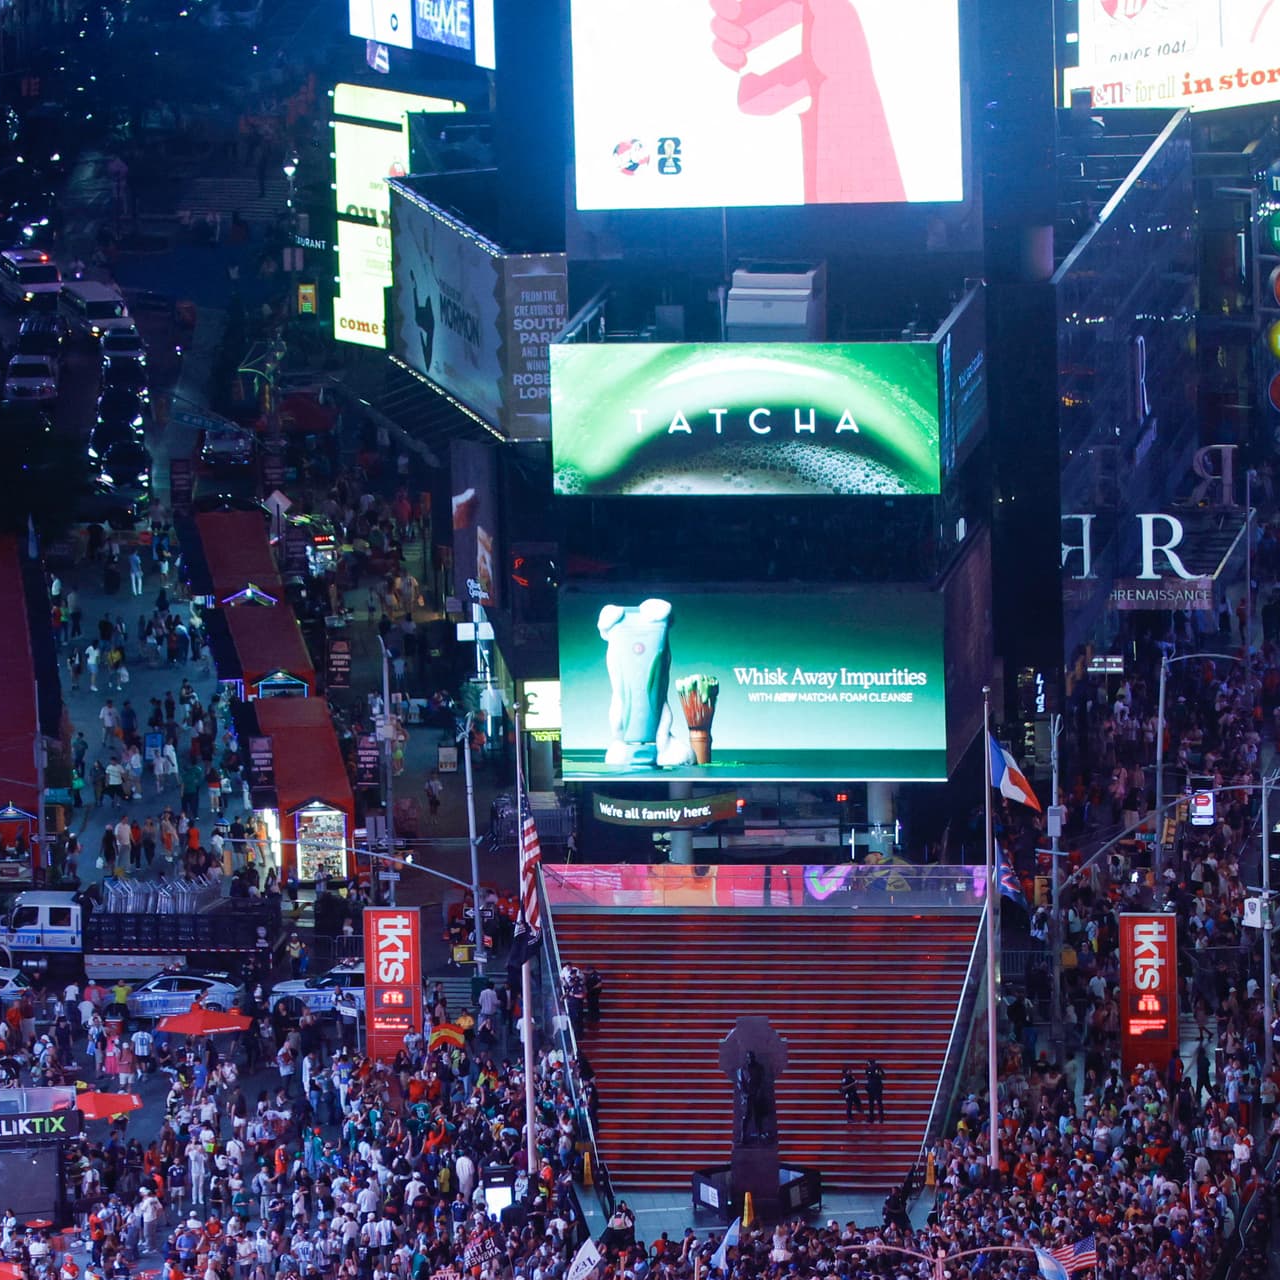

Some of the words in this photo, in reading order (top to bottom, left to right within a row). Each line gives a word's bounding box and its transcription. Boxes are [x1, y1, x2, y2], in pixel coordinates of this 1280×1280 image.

[1135, 82, 1156, 103] for
[1158, 75, 1176, 99] all
[1181, 71, 1213, 96] in
[521, 291, 542, 302] FROM
[544, 291, 558, 302] THE
[514, 305, 553, 317] CREATORS
[554, 305, 565, 316] OF
[340, 316, 379, 335] come
[513, 318, 566, 331] SOUTH
[513, 374, 551, 386] ROBE
[520, 387, 551, 399] LOP
[629, 408, 860, 434] TATCHA
[1135, 513, 1208, 580] R
[1118, 590, 1211, 601] RENAISSANCE
[733, 668, 788, 686] Whisk
[791, 668, 837, 689] Away
[840, 668, 927, 689] Impurities
[748, 693, 772, 703] WITH
[798, 693, 837, 703] MATCHA
[839, 693, 868, 703] FOAM
[868, 693, 913, 703] CLEANSE
[1035, 673, 1045, 713] Lids
[599, 802, 623, 817] We're
[625, 804, 639, 818] all
[641, 804, 681, 822] family
[377, 915, 412, 983] tkts
[1133, 921, 1168, 990] tkts
